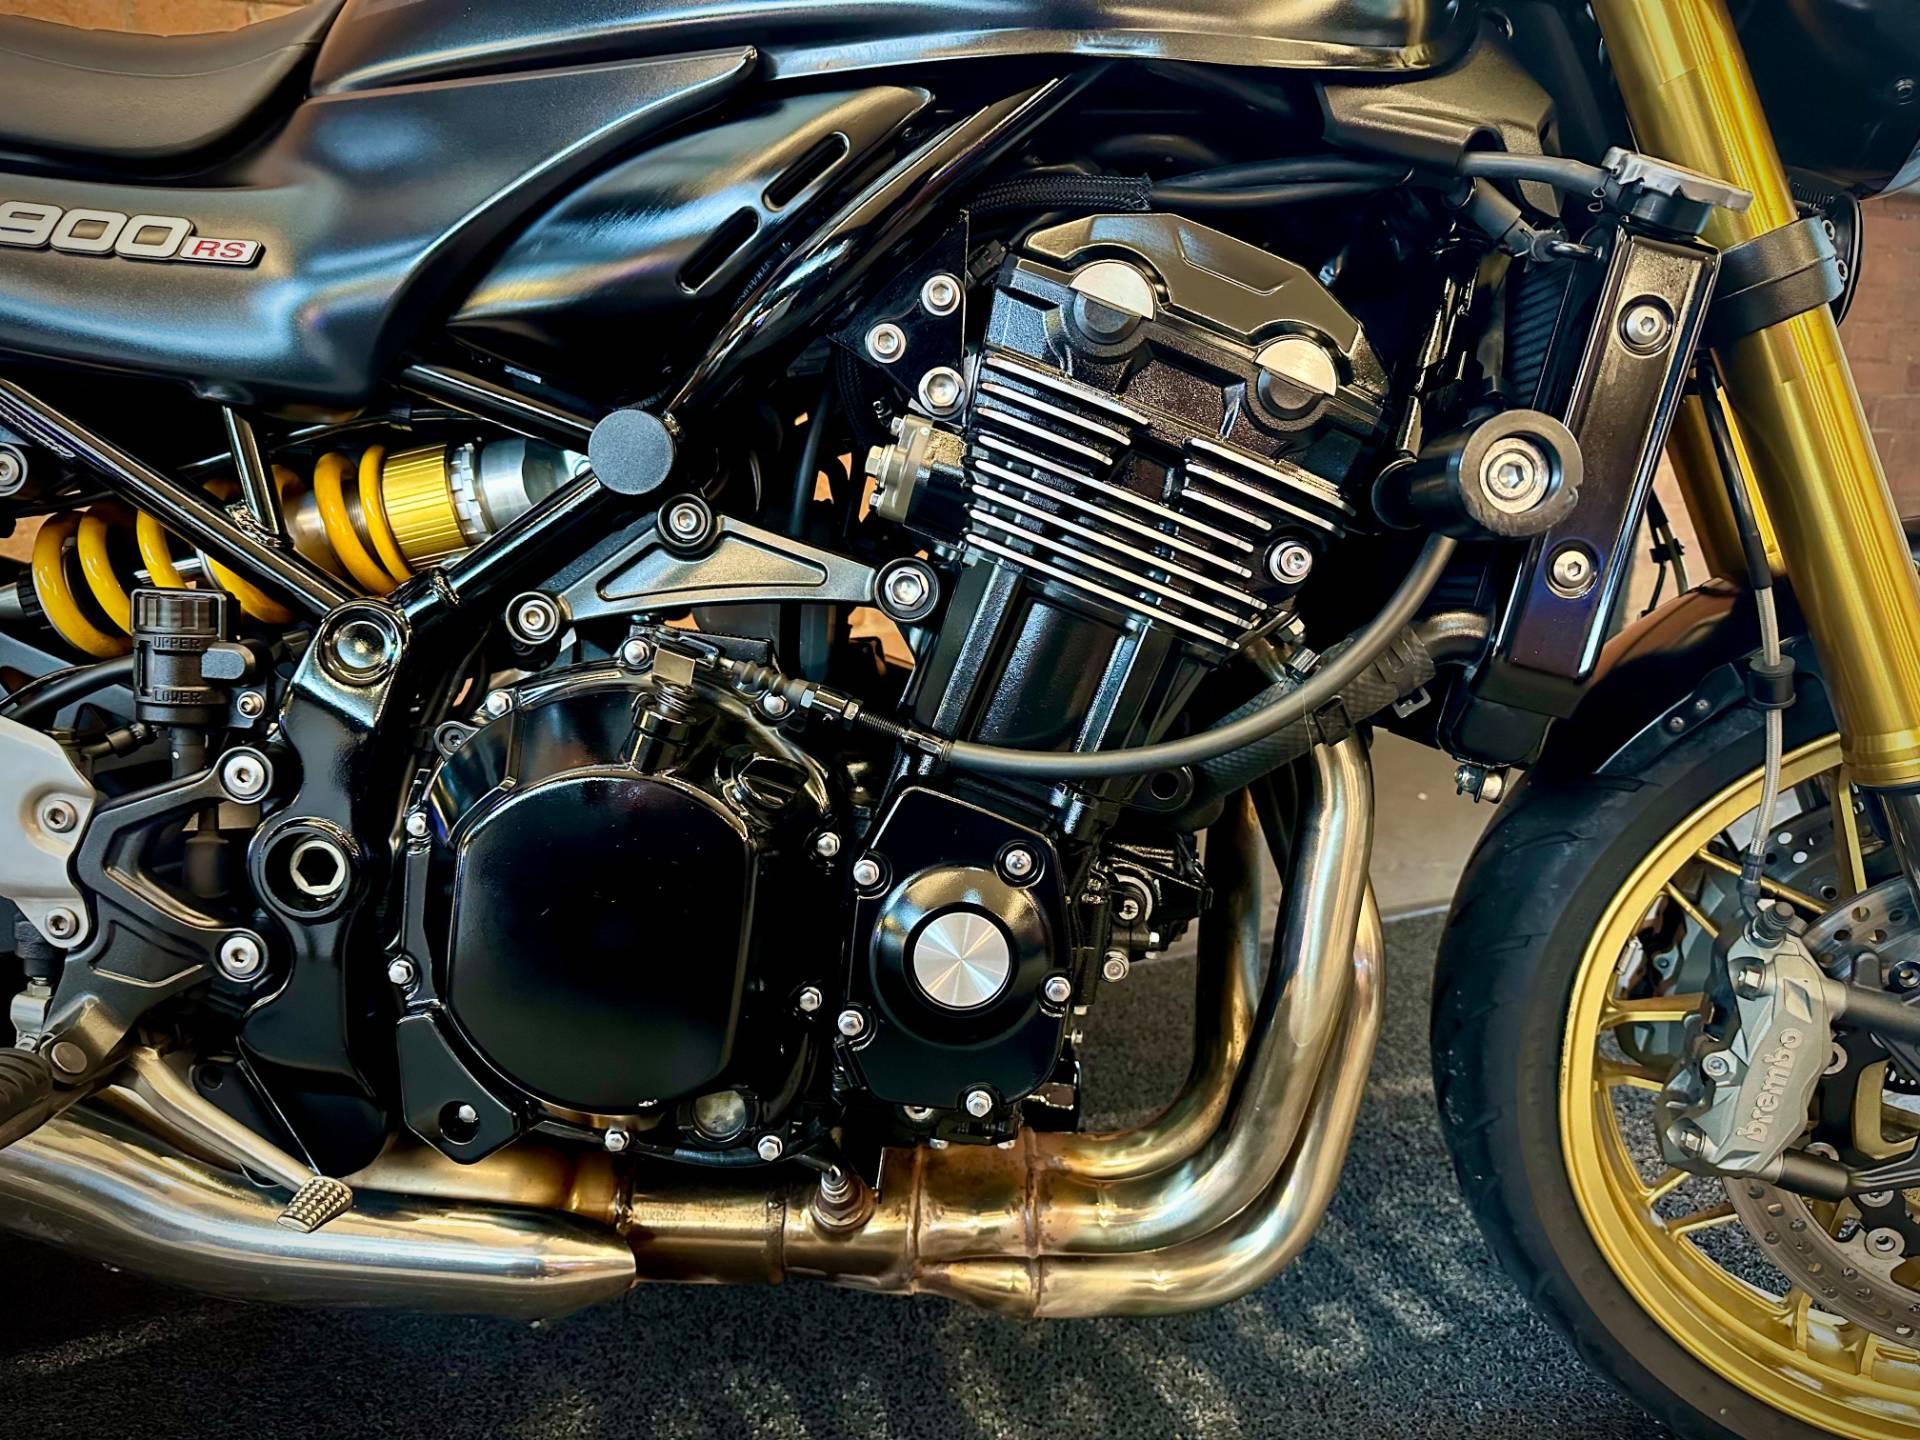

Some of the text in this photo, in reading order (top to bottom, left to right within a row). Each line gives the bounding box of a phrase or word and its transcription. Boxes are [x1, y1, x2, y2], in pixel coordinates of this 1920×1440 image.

[191, 239, 247, 258] RS
[153, 636, 201, 649] UPPER
[154, 689, 202, 703] LOWER
[1736, 1027, 1803, 1142] brembo
